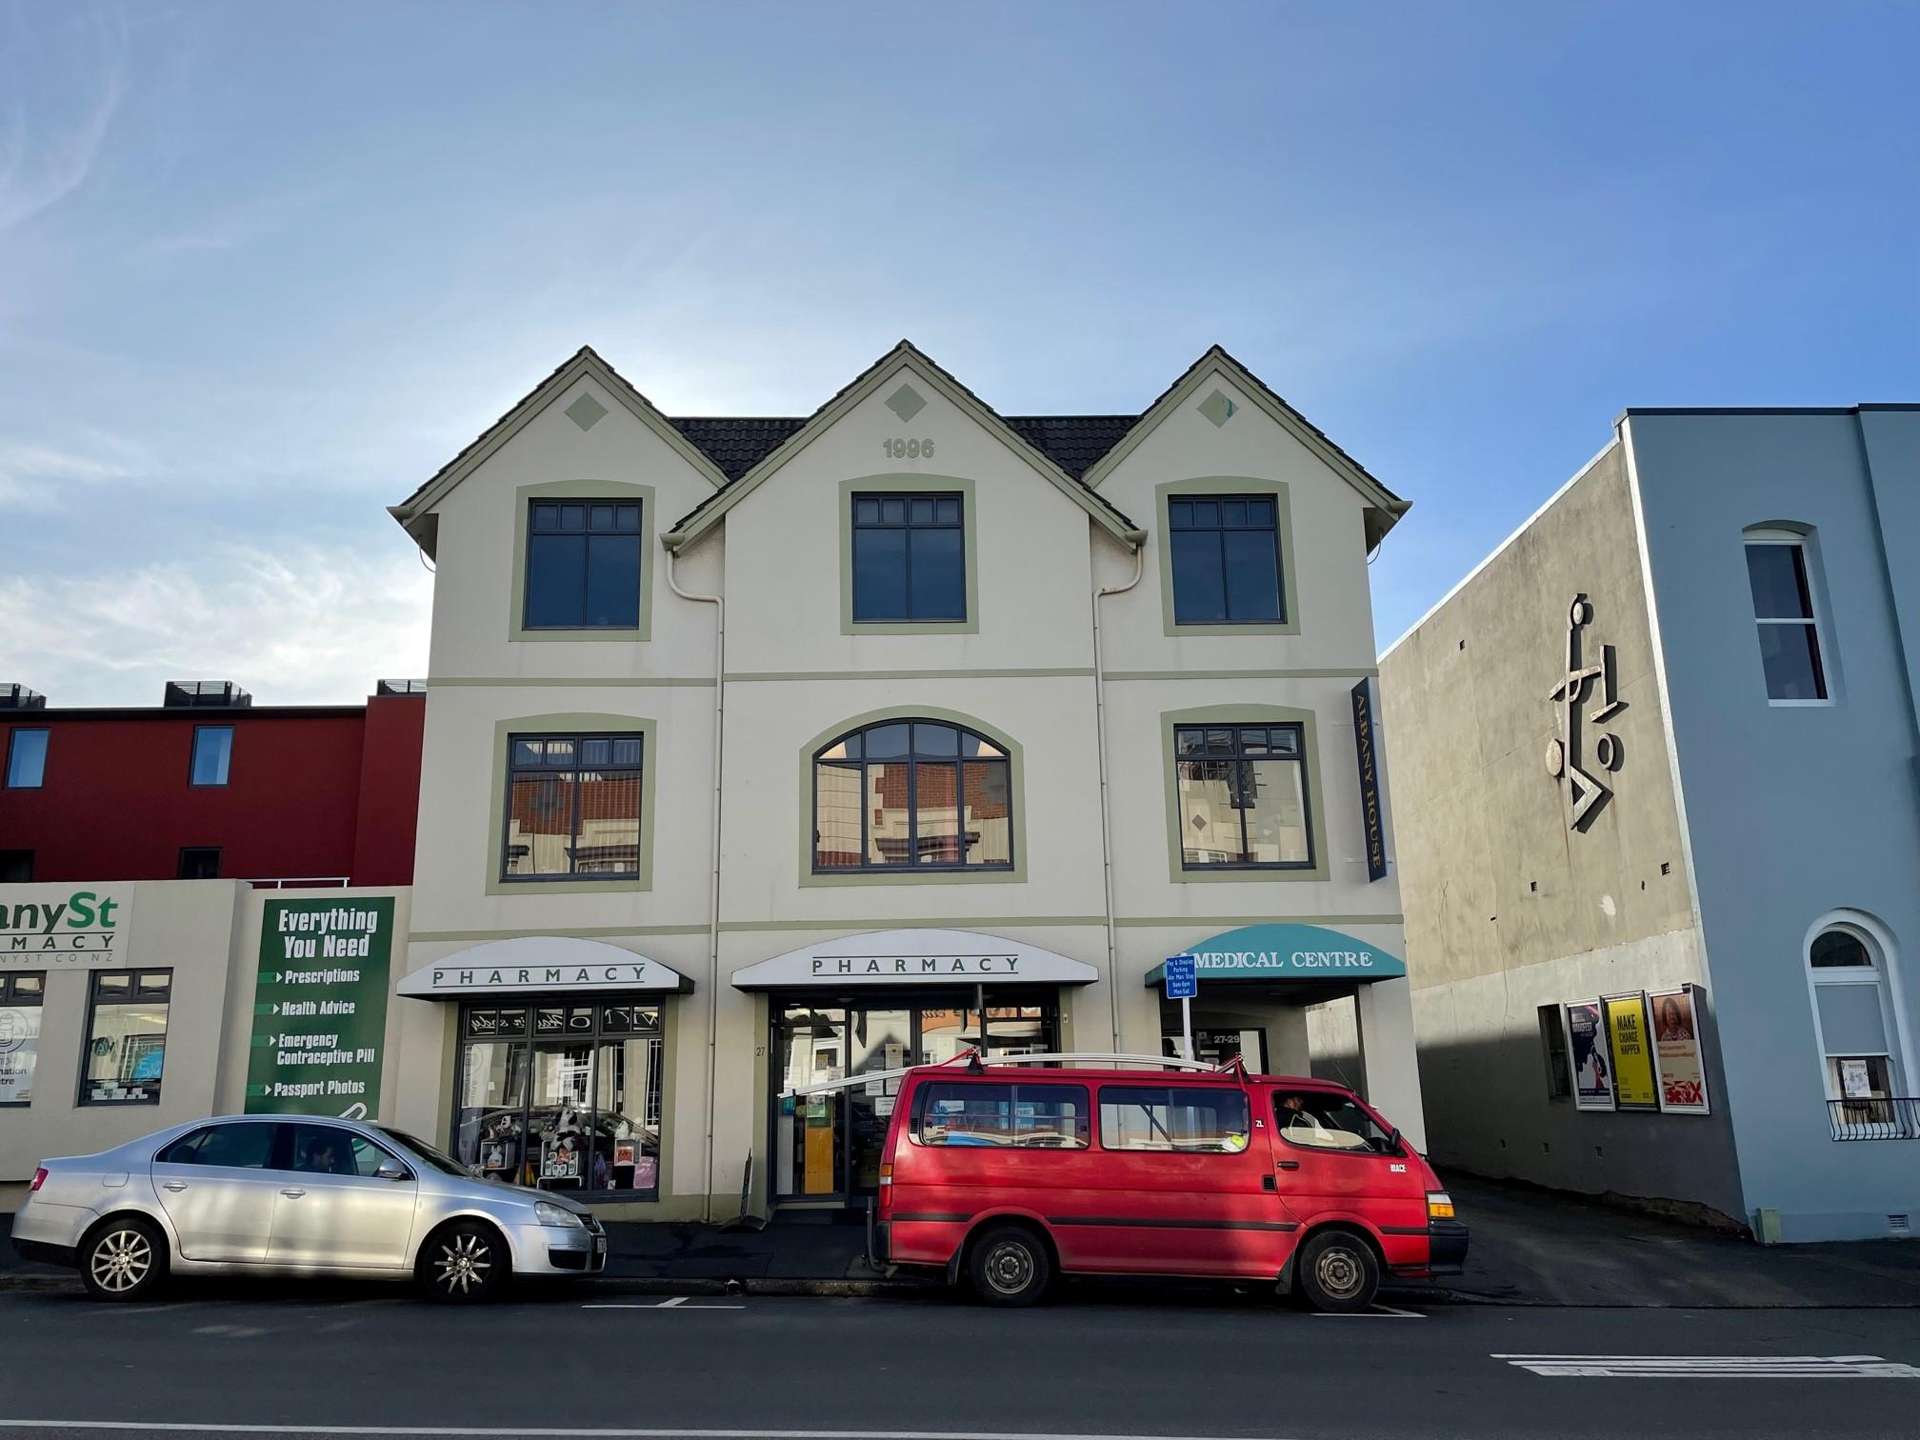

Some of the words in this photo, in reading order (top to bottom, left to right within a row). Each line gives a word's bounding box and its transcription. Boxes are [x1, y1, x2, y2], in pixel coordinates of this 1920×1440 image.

[883, 438, 935, 458] 1996
[1357, 695, 1373, 782] ALBANY
[1366, 790, 1382, 868] HOUSE
[278, 908, 378, 934] Everything
[11, 935, 114, 950] MACY
[284, 935, 316, 958] You
[323, 934, 370, 957] Need
[812, 958, 1018, 973] PHARMACY
[1193, 951, 1284, 968] MEDICAL
[1291, 951, 1373, 967] CENTRE
[284, 969, 360, 984] Prescriptions
[433, 967, 645, 984] PHARMACY
[282, 1001, 317, 1016] Health
[320, 1000, 356, 1015] Advice
[1616, 1014, 1638, 1031] MAKE
[278, 1033, 339, 1049] Emergency
[1214, 1035, 1240, 1044] 27-29
[277, 1050, 353, 1066] Contraceptive
[356, 1048, 375, 1063] Pill
[274, 1081, 324, 1097] Passport
[327, 1080, 365, 1095] Photos
